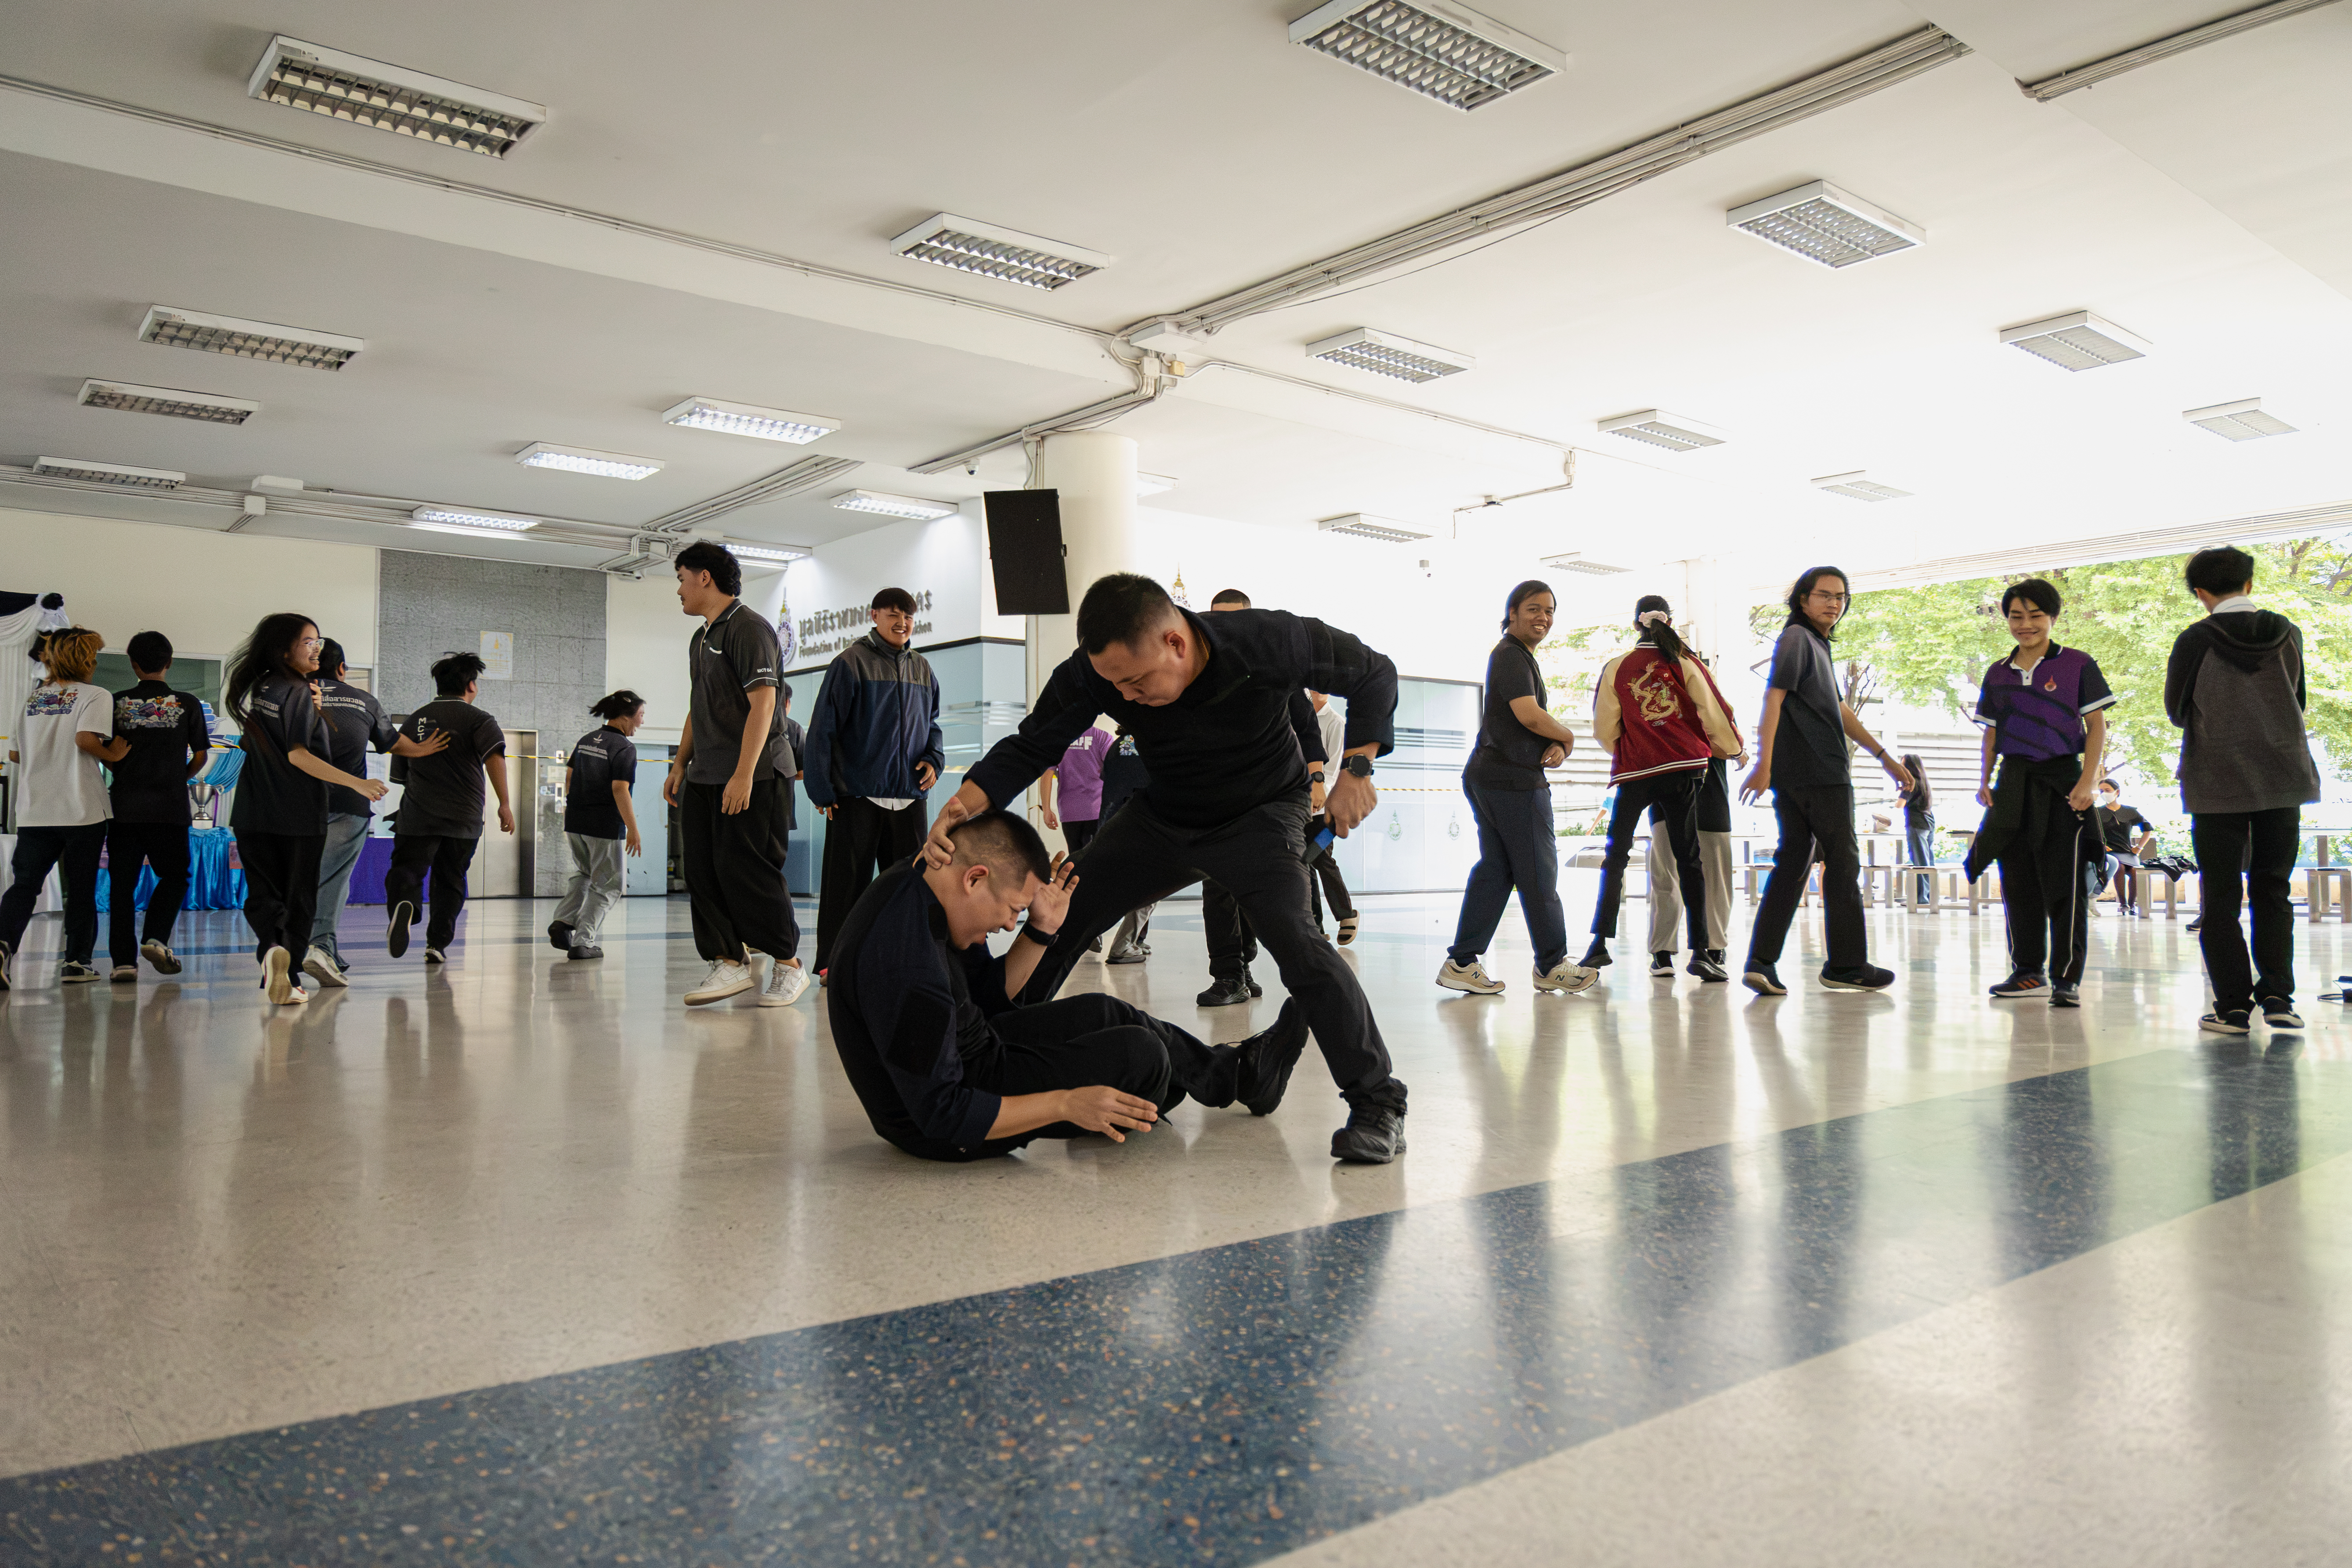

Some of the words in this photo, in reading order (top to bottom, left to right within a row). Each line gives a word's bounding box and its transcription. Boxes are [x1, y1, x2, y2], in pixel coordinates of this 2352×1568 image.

[799, 640, 832, 658] Foundation
[834, 636, 840, 650] of
[417, 717, 426, 741] MCT
[1471, 971, 1481, 979] N
